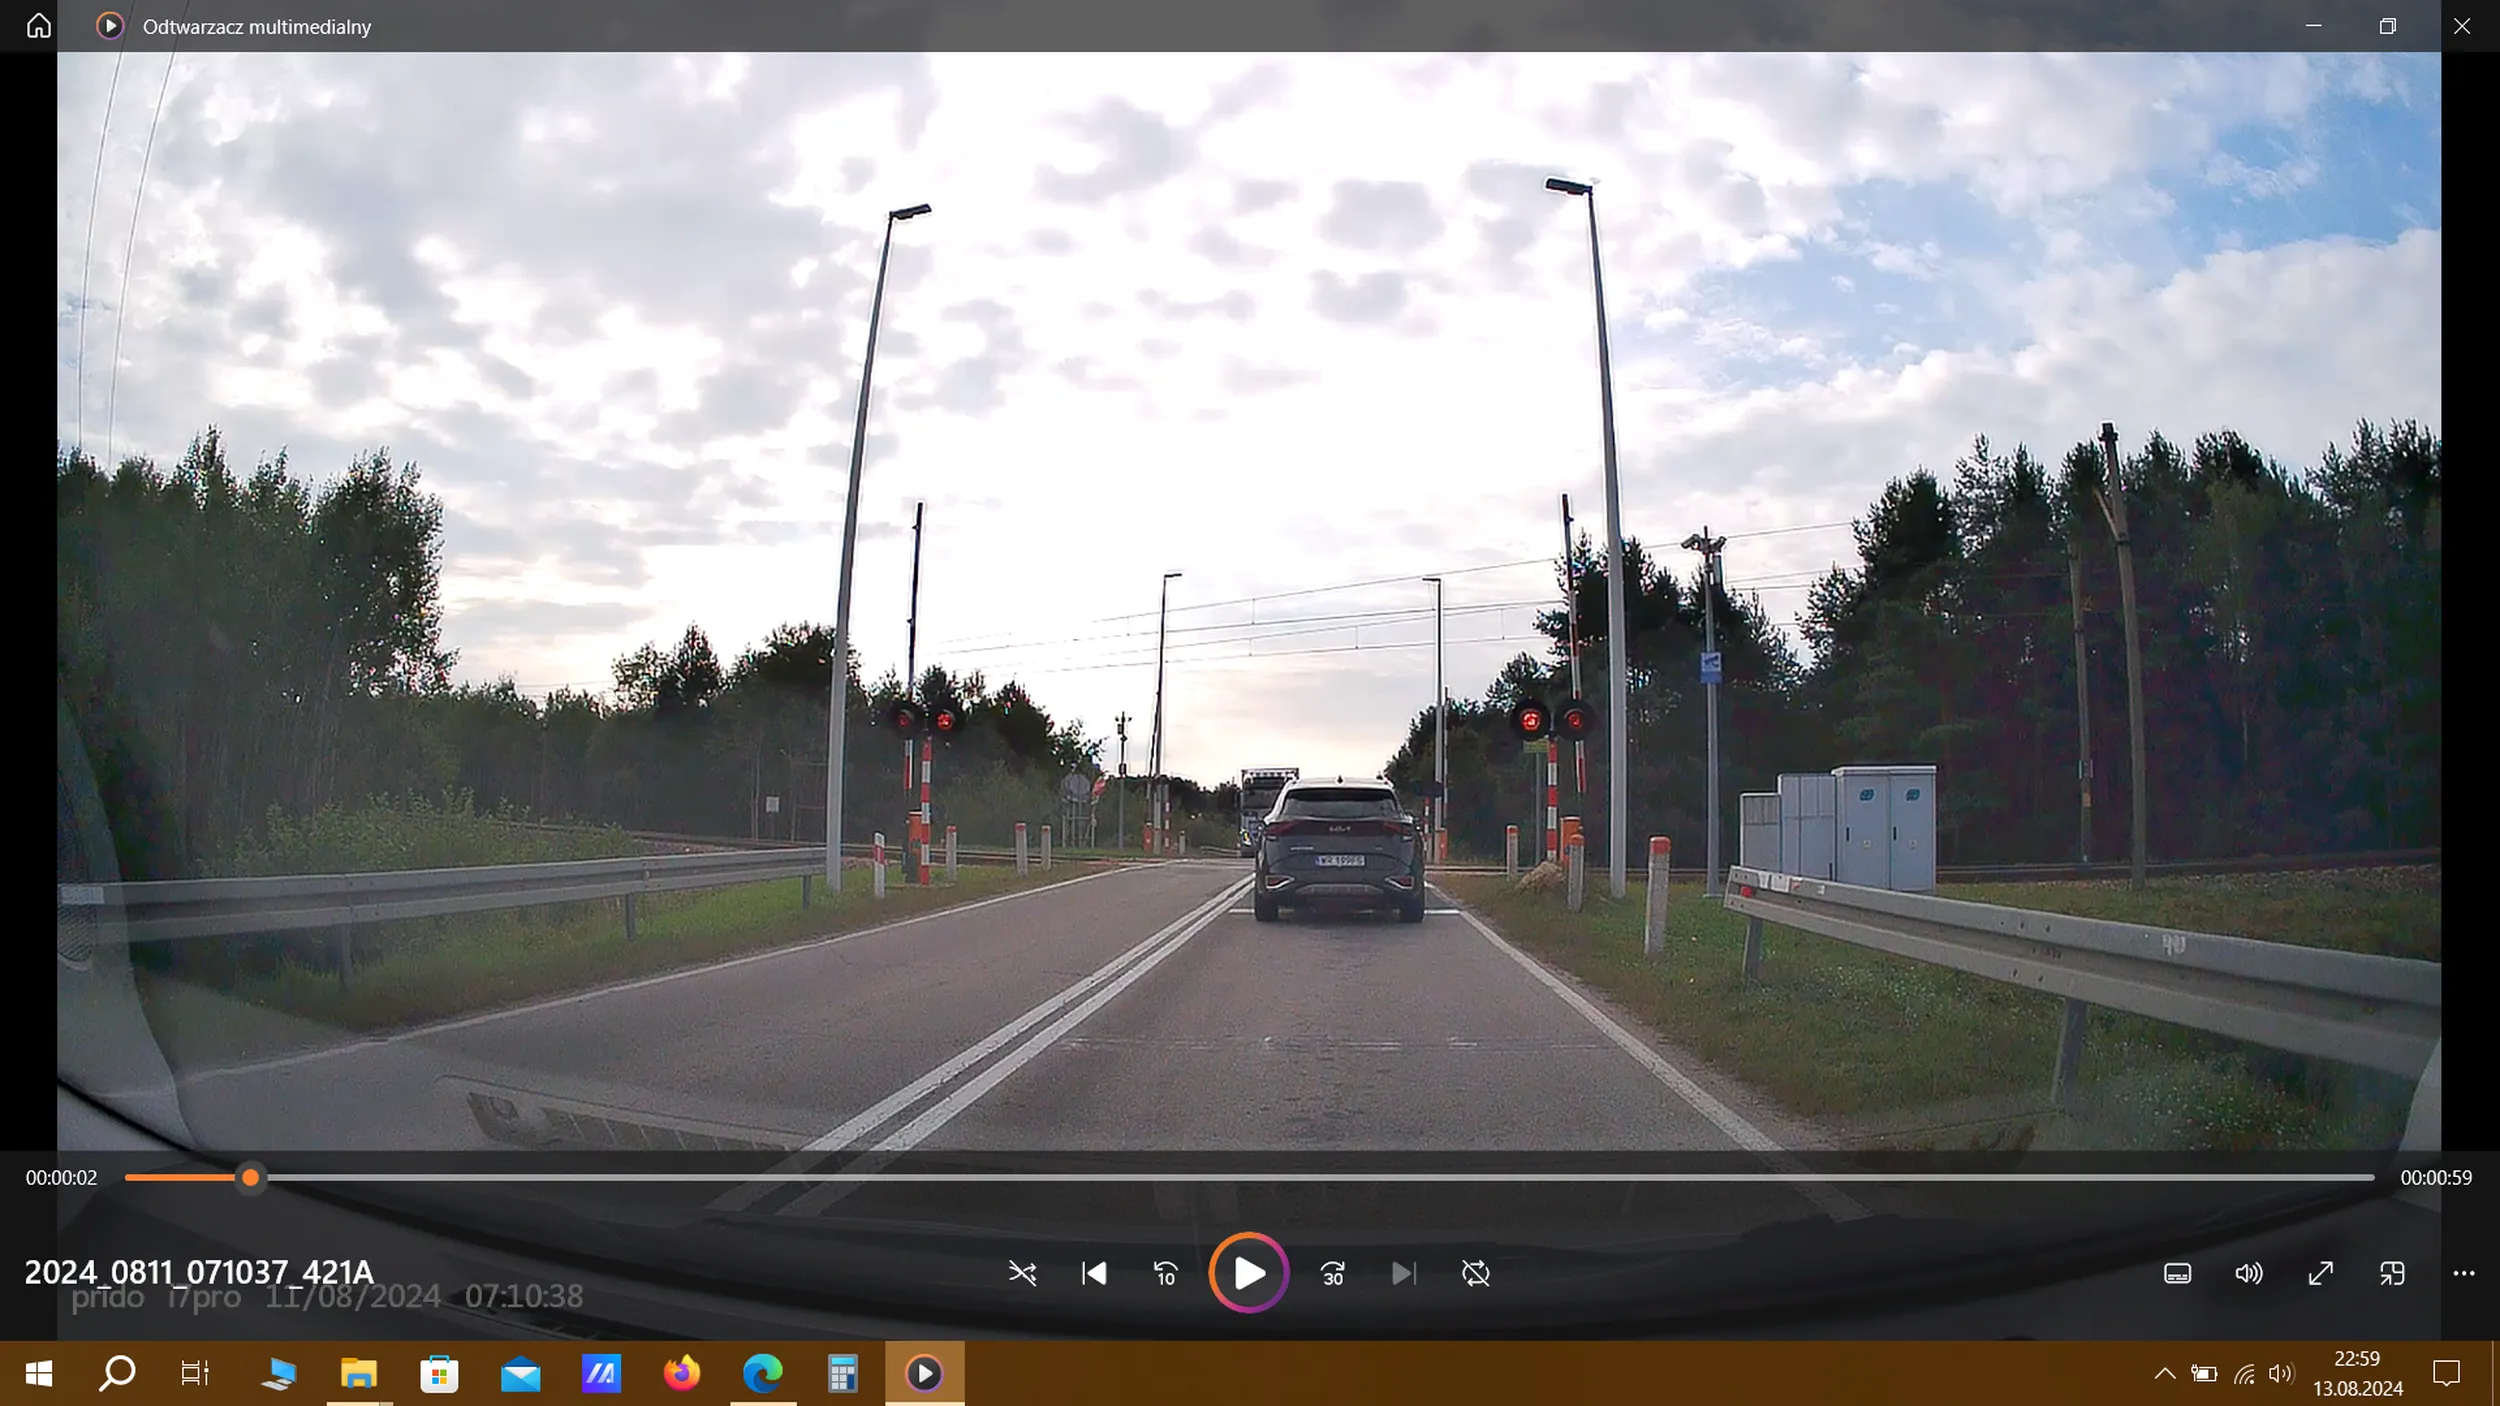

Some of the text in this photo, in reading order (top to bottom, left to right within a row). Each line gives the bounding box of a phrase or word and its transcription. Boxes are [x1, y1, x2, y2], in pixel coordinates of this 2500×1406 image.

[143, 18, 372, 39] Odtwarzacz multimedialny
[25, 1169, 98, 1186] 00:00:02
[2400, 1169, 2473, 1186] 00:00:59
[25, 1259, 375, 1290] 2024_0811_071037_421A
[1157, 1272, 1176, 1286] 10
[1323, 1272, 1344, 1286] 30
[2334, 1350, 2381, 1367] 22:59
[2313, 1380, 2404, 1397] 13.08.2024
